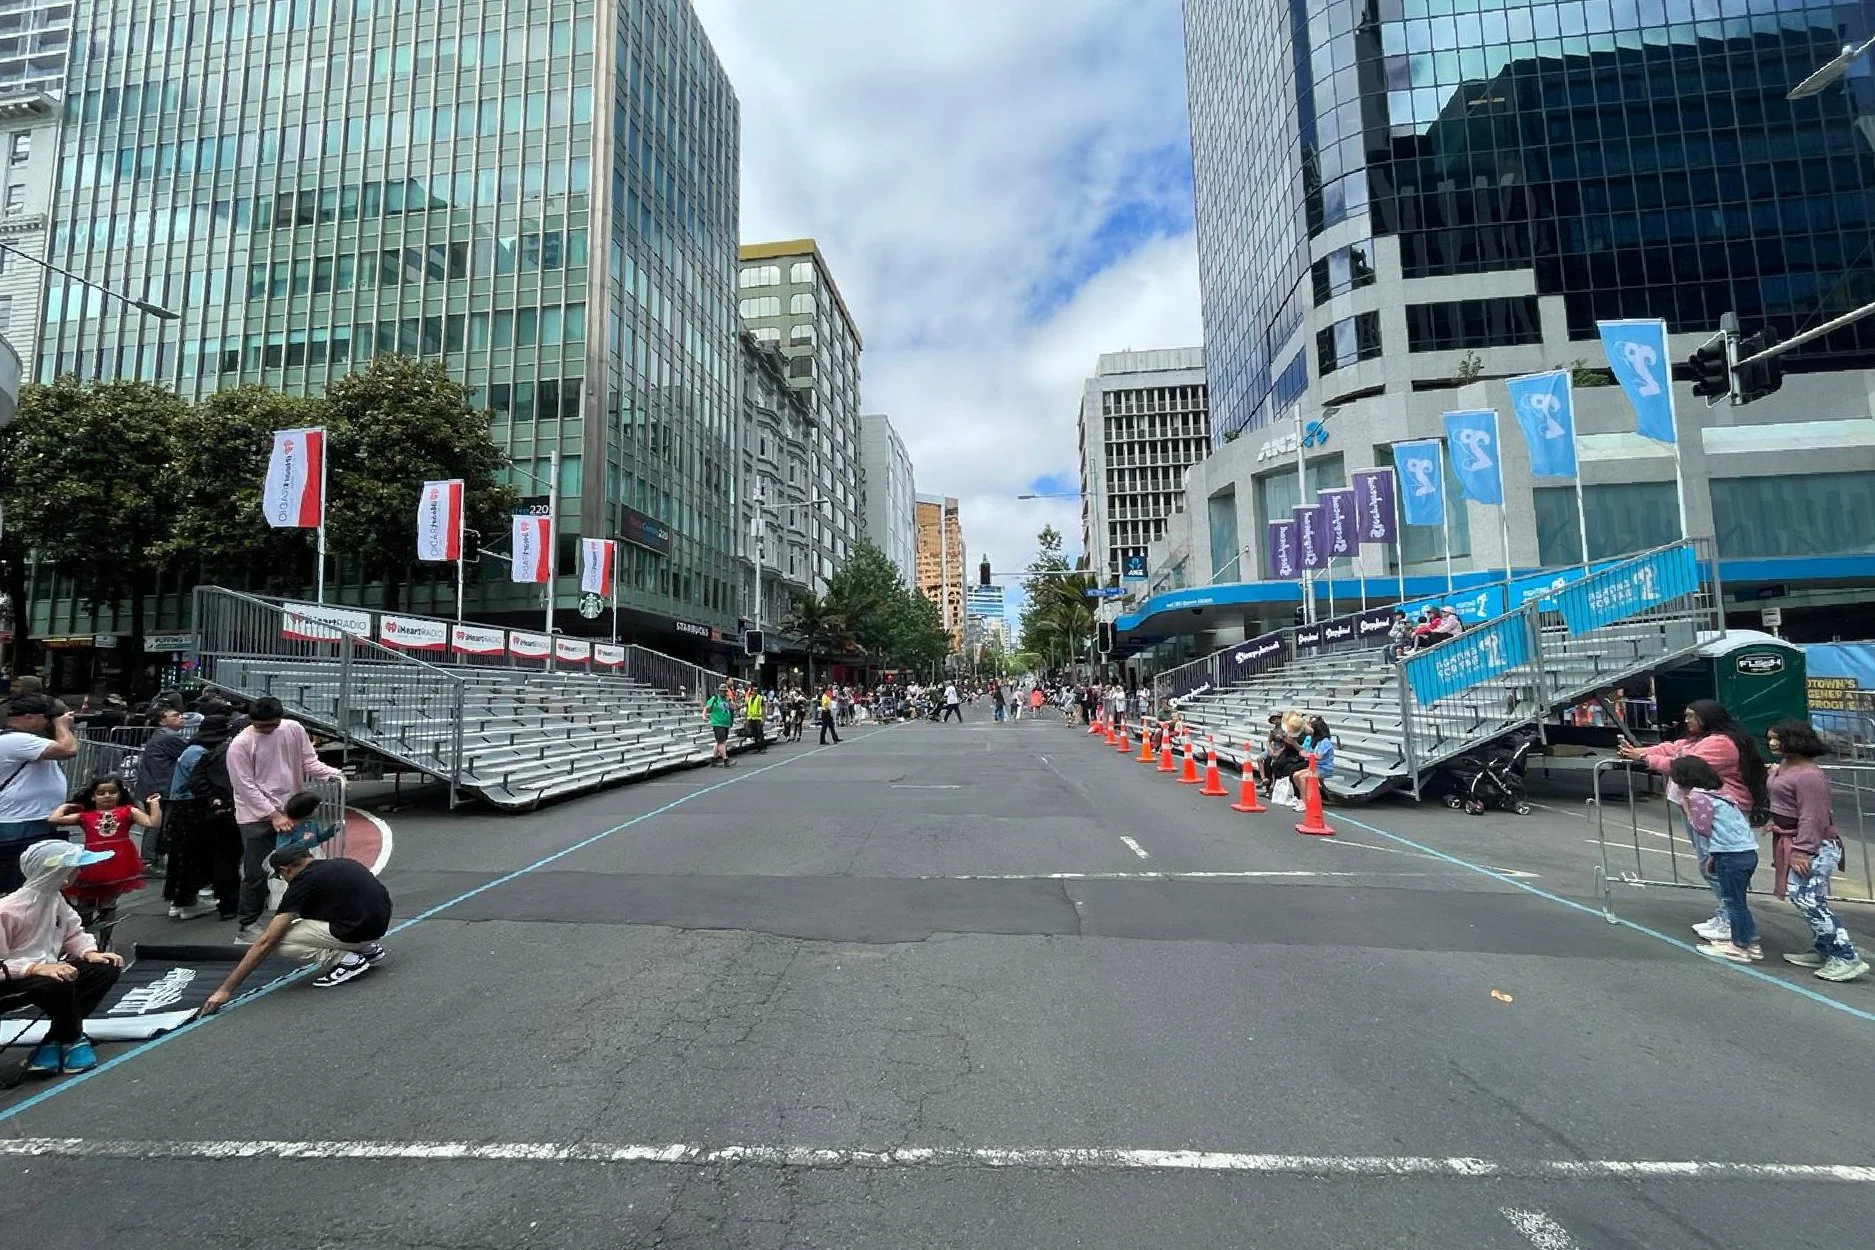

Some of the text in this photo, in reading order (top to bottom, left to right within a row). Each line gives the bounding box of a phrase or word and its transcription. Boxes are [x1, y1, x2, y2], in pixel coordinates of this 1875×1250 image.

[1257, 432, 1297, 462] ANZ
[530, 505, 549, 514] 220
[397, 624, 443, 638] iHeartRADIO
[676, 621, 709, 637] STARBUCKS
